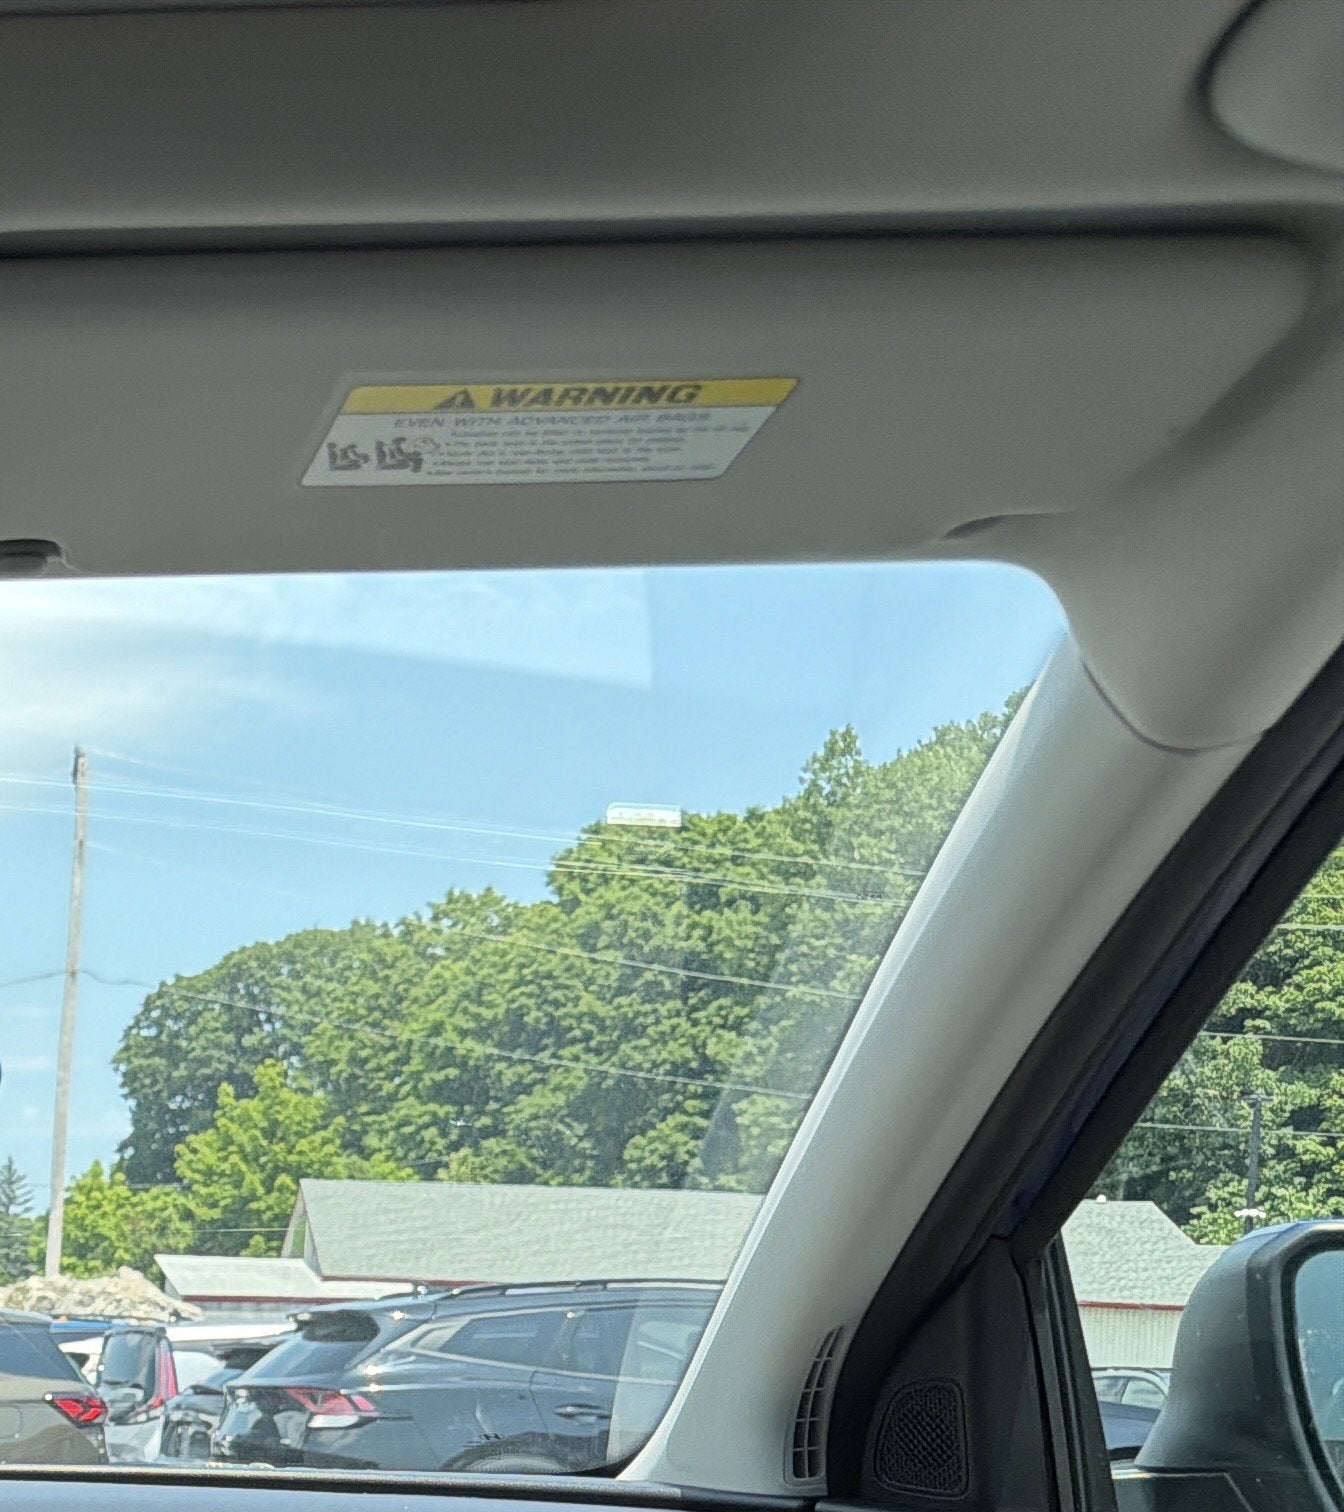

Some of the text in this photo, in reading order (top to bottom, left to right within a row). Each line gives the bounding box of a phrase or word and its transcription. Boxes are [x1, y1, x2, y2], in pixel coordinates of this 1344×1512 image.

[490, 385, 703, 407] WARNING
[394, 417, 445, 428] EVEN
[454, 417, 502, 427] WITH
